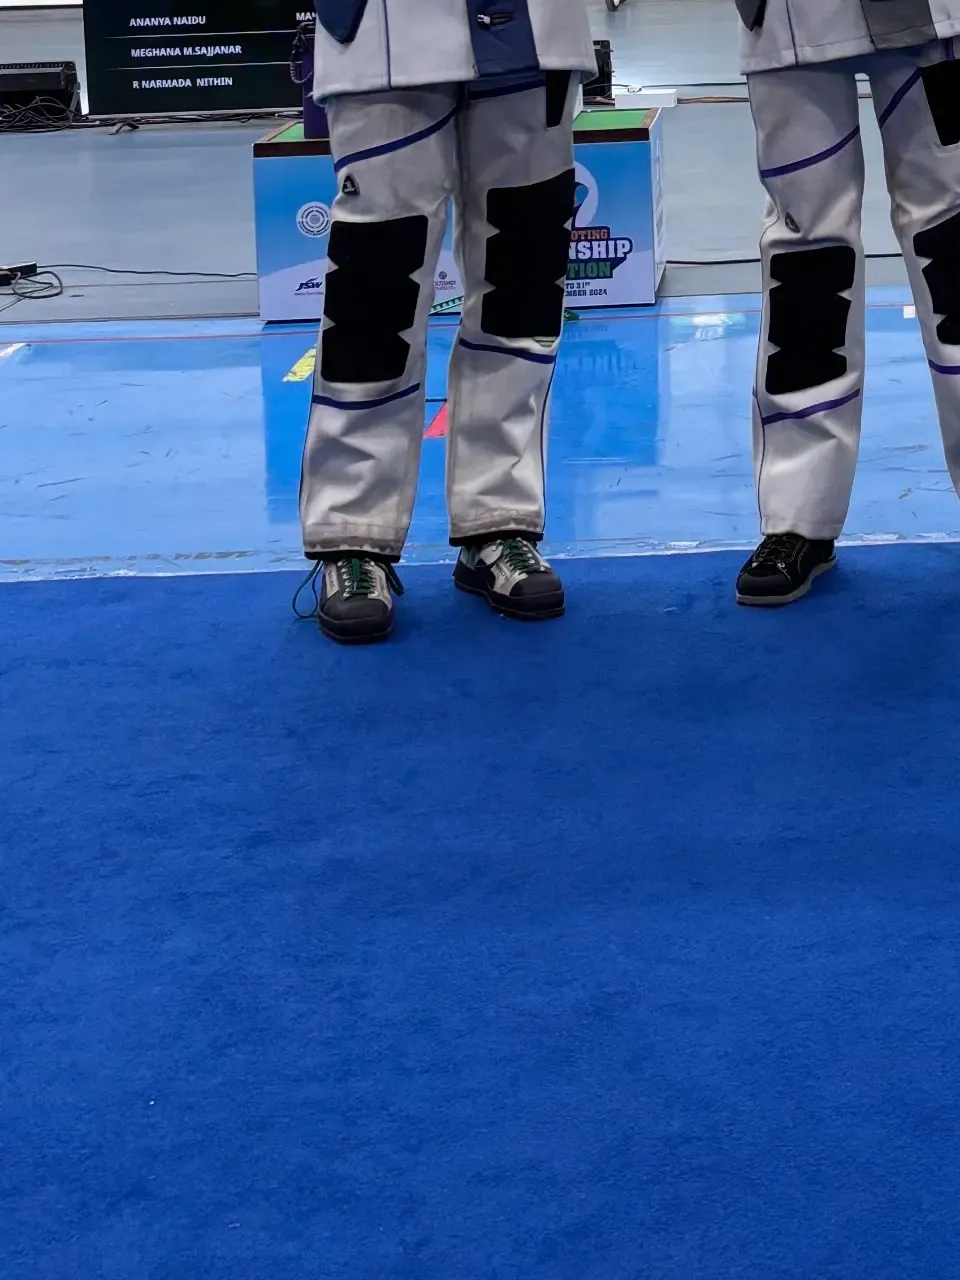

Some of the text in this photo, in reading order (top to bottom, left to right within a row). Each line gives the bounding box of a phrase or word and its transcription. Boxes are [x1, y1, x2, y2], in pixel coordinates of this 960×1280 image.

[129, 15, 206, 27] ANANYA NAIDU
[131, 45, 242, 58] MEGHANA M.SAJJANAR
[132, 76, 233, 89] R NARMADA NITHIN
[571, 229, 608, 240] OTING
[568, 261, 611, 278] TION
[295, 280, 323, 291] JSW
[566, 288, 607, 297] MBER 2024
